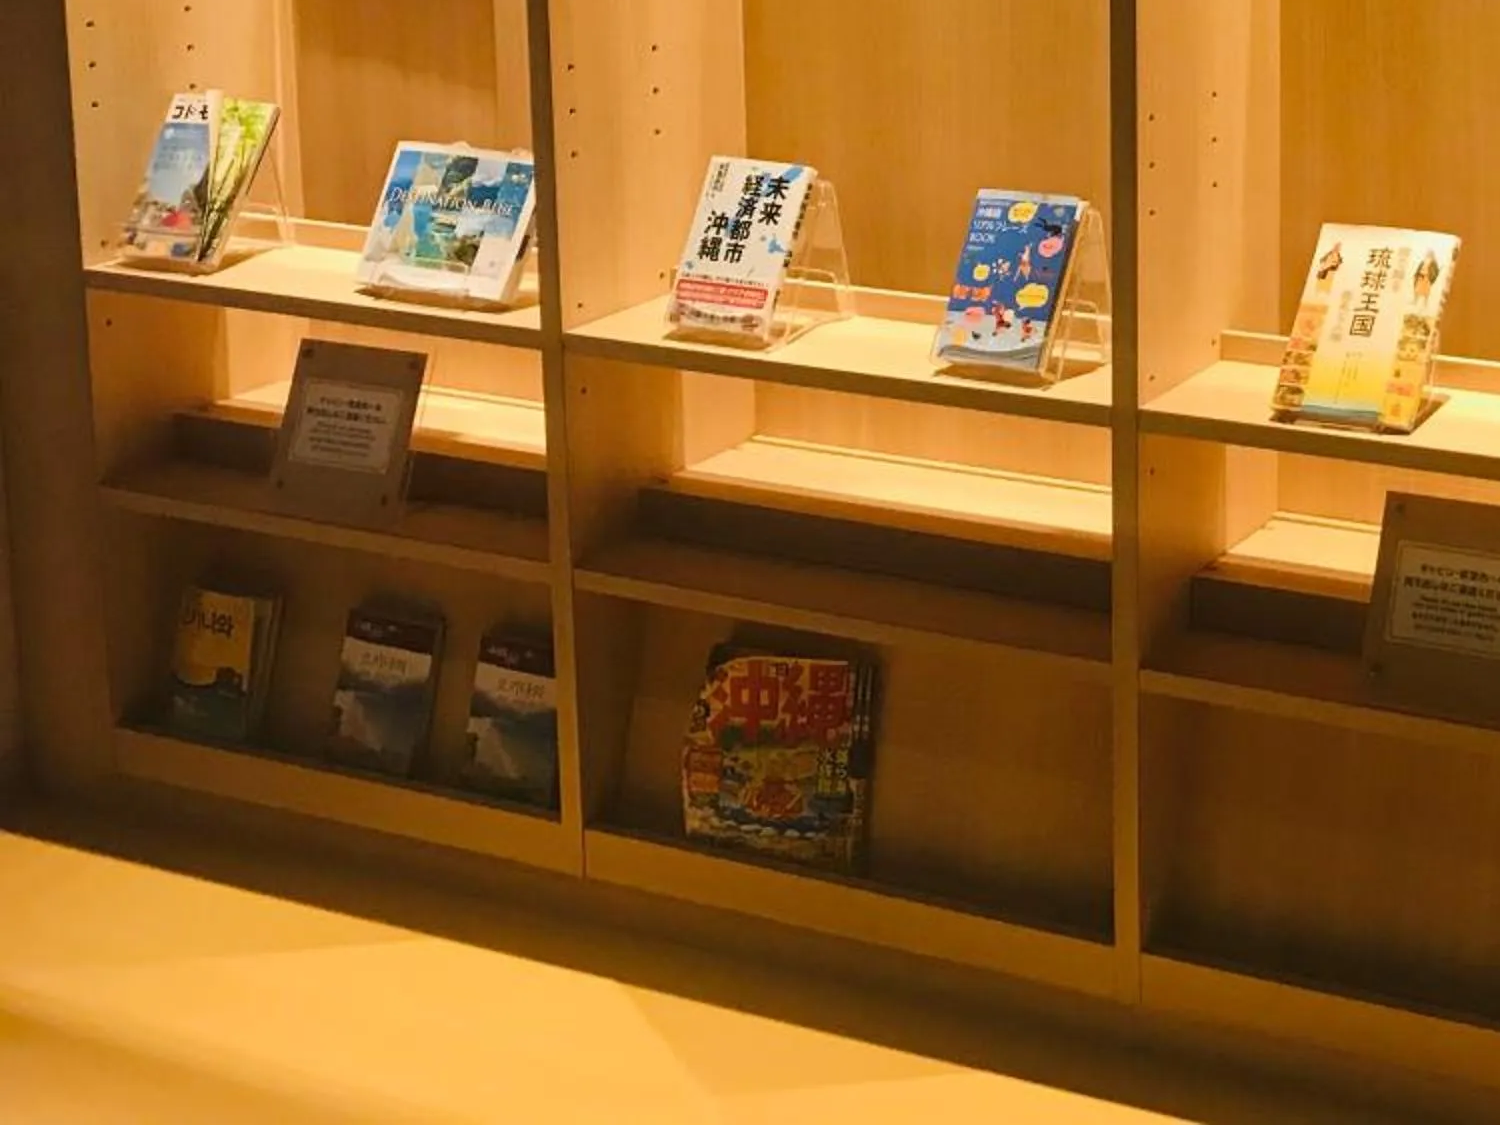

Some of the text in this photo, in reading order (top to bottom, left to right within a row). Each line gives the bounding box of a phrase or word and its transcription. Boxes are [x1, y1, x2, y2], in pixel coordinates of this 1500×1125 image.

[724, 175, 765, 263] 経済都市
[757, 176, 790, 226] 未来
[698, 210, 728, 263] 沖縄
[1349, 247, 1394, 338] 琉球王国
